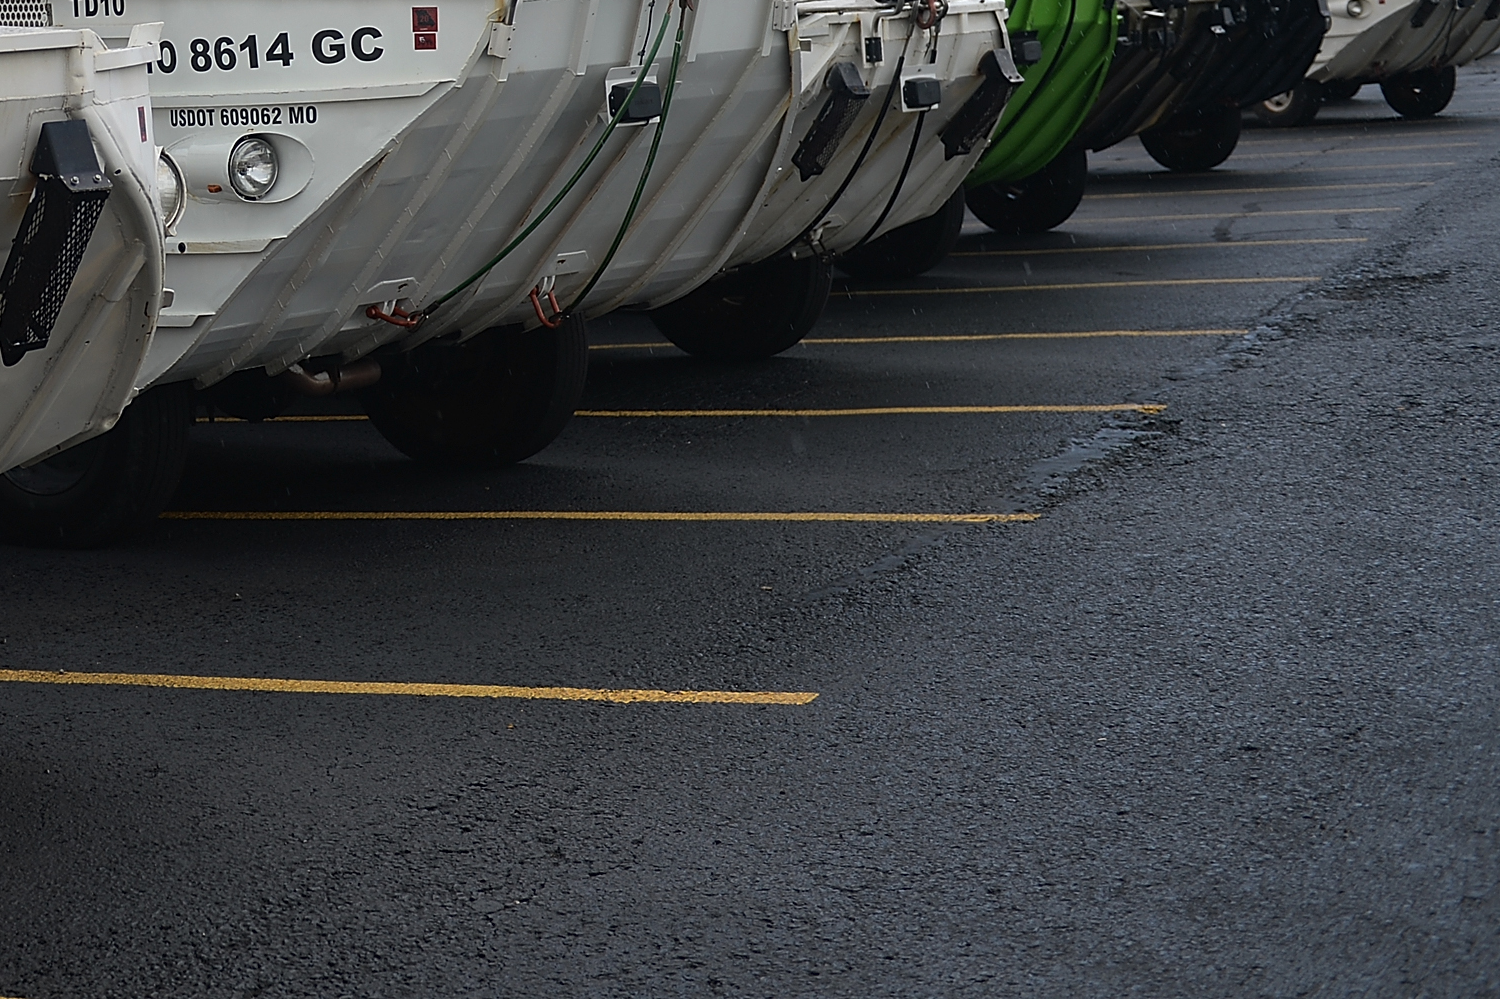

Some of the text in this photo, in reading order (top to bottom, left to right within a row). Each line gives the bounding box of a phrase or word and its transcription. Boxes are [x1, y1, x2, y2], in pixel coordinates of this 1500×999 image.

[147, 26, 385, 74] O 8614 GC
[170, 105, 317, 127] USDOT 609062 MO
